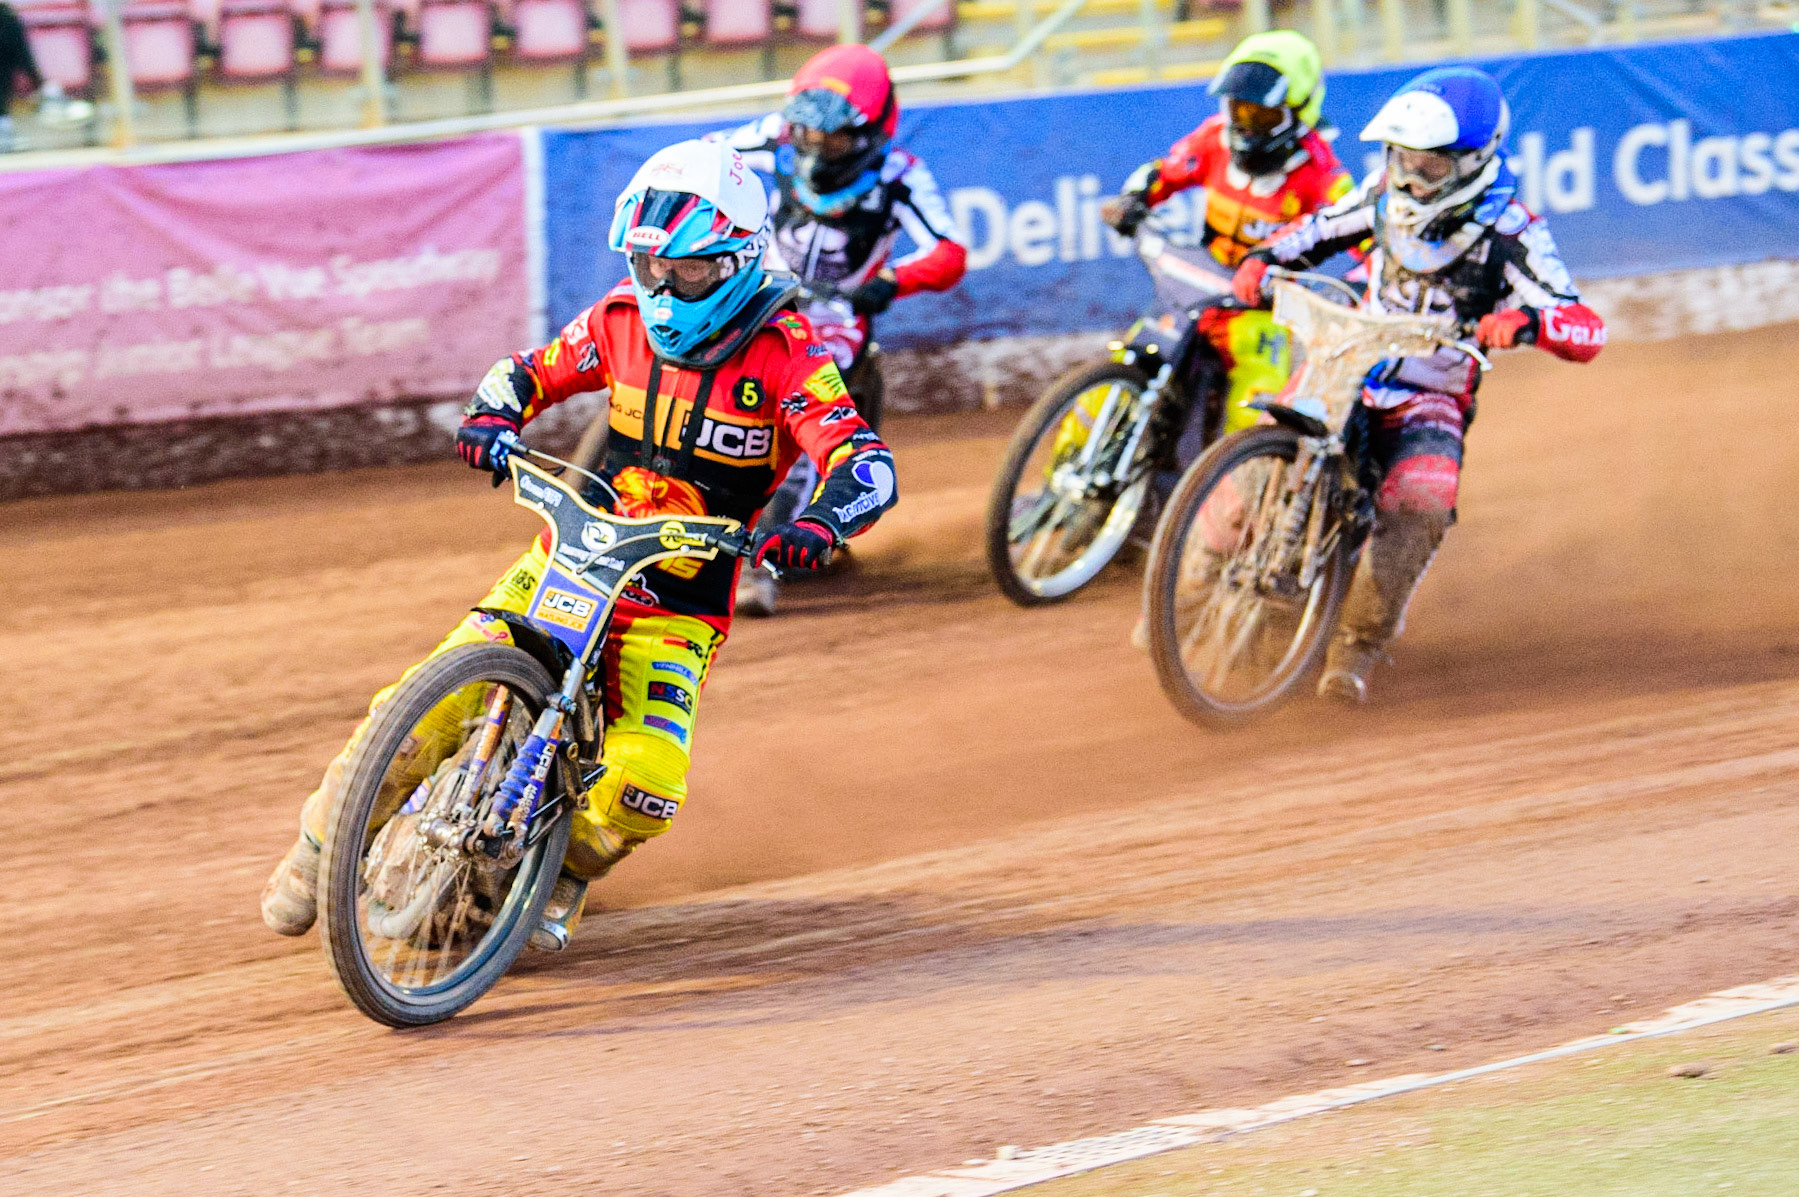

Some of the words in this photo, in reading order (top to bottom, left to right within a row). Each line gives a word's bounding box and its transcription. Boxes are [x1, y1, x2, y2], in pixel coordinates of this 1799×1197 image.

[632, 231, 661, 242] BELL
[741, 382, 759, 407] 5
[681, 418, 773, 458] JCB
[543, 593, 592, 618] JCB
[623, 791, 679, 819] JCB
